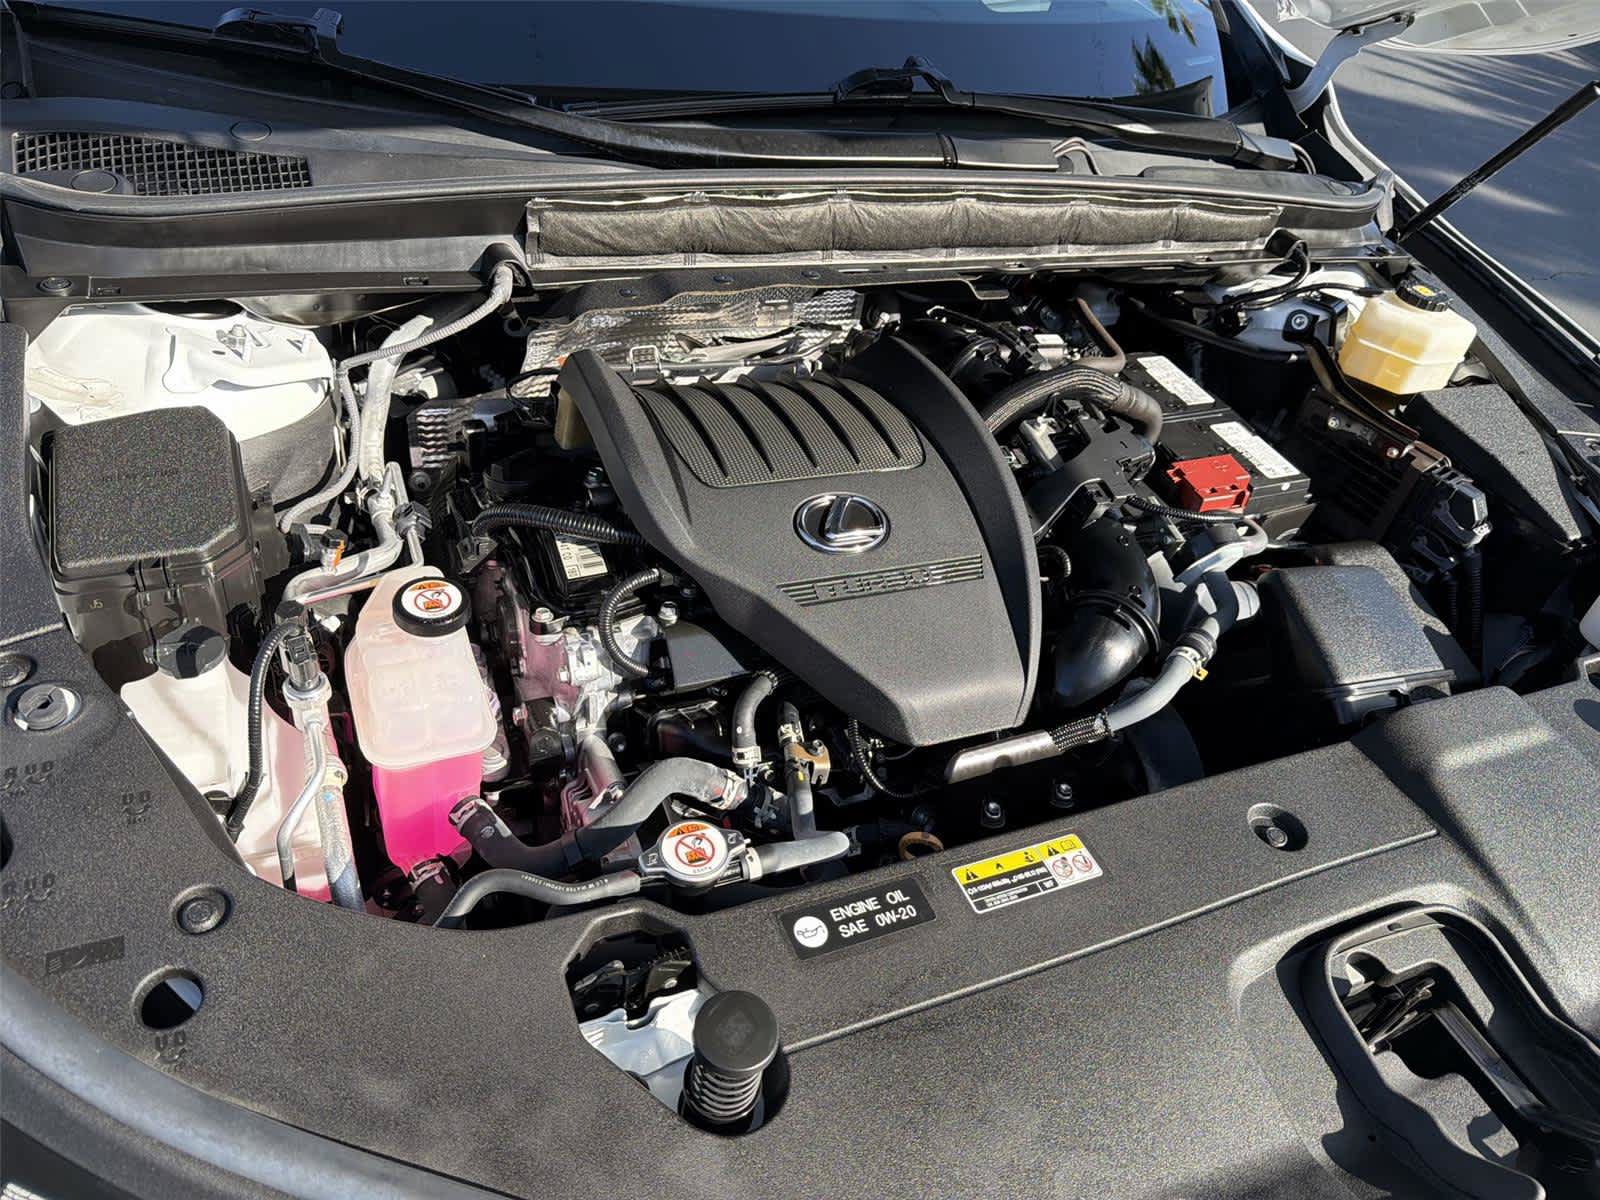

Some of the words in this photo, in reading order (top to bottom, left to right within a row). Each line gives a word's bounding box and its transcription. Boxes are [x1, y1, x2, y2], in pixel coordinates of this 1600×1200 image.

[830, 897, 881, 922] ENGINE
[886, 889, 911, 905] OIL
[838, 919, 870, 938] SAE
